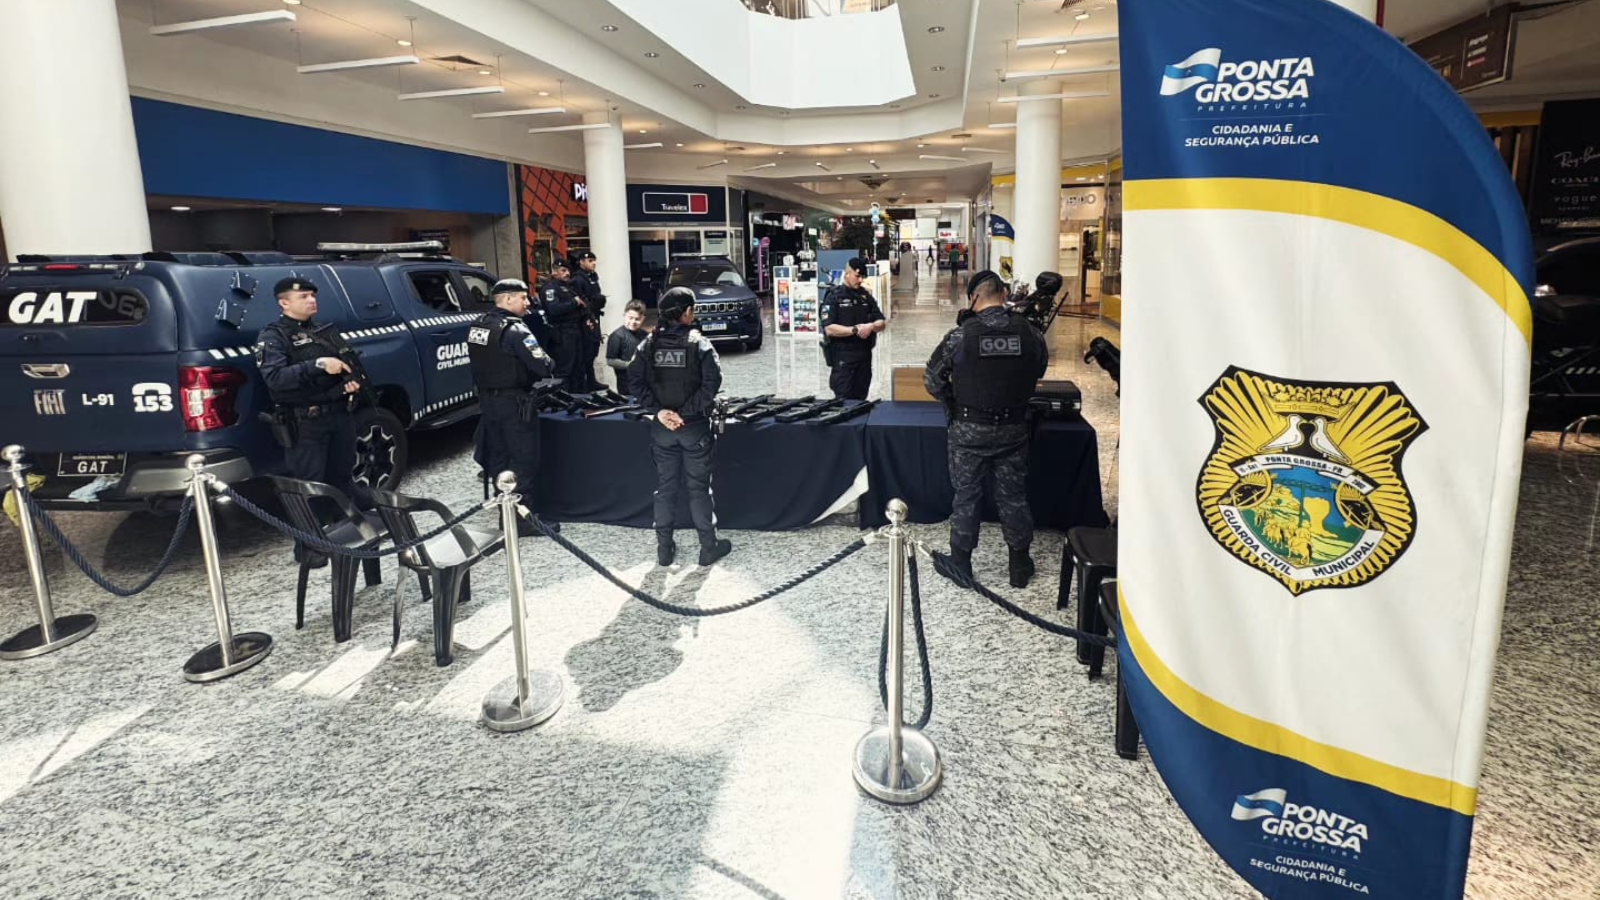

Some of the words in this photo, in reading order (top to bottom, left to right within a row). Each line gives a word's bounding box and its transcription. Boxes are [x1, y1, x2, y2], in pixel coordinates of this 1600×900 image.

[1217, 57, 1315, 82] PONTA
[1195, 79, 1309, 103] GROSSA
[1197, 102, 1307, 112] PREFEITURA
[1211, 124, 1282, 135] CIDADANIA
[1284, 123, 1294, 133] E
[1184, 137, 1260, 148] SEGURANÇA
[1262, 134, 1320, 146] PÚBLICA
[661, 203, 688, 212] Travelex
[8, 291, 98, 324] GAT
[469, 329, 490, 343] GCM
[981, 337, 1019, 351] GOE
[436, 342, 470, 361] GUAR
[654, 351, 684, 363] GAT
[33, 388, 67, 415] FIAT
[81, 393, 115, 406] L-91
[133, 395, 174, 413] 153
[77, 460, 108, 473] GAT
[1293, 458, 1327, 469] GROSSA
[1223, 509, 1260, 553] GUARDA
[1260, 552, 1293, 576] CIVIL
[1312, 541, 1375, 577] MUNICIPAL
[1282, 802, 1369, 840] PONTA
[1261, 817, 1361, 853] GROSSA
[1275, 855, 1336, 873] CIDADANIA
[1337, 867, 1347, 877] E
[1249, 858, 1317, 882] SEGURANÇA
[1319, 873, 1370, 895] PÚBLICA
